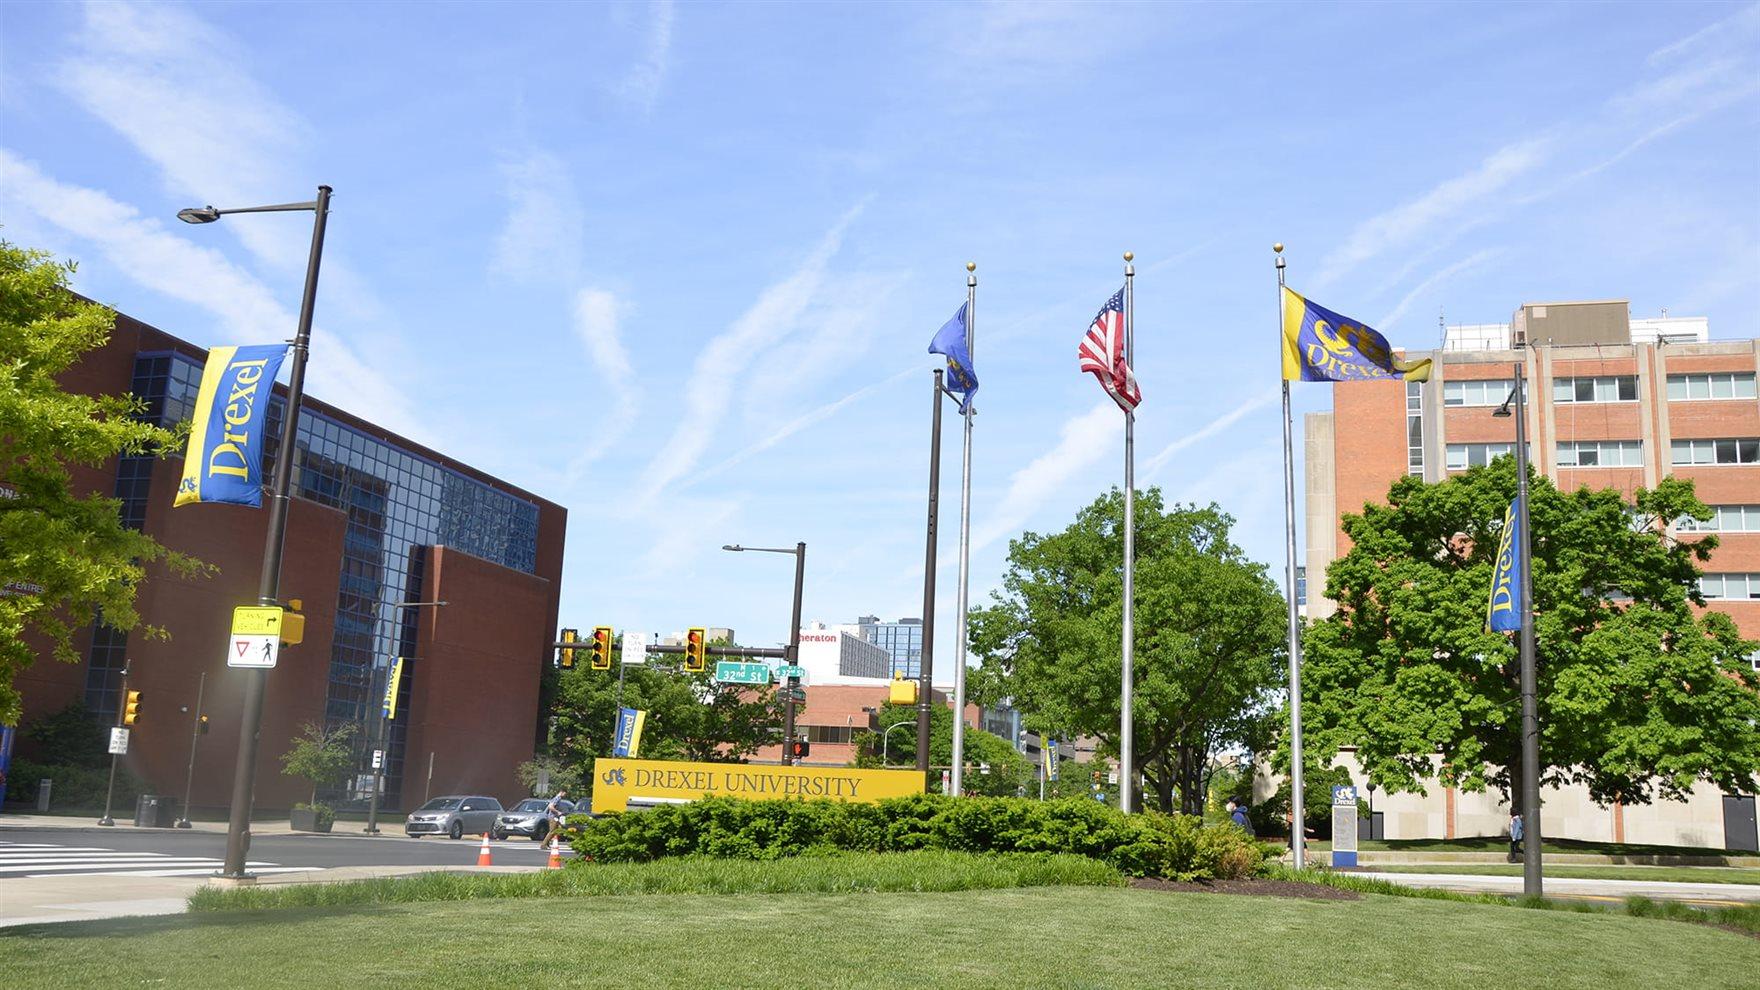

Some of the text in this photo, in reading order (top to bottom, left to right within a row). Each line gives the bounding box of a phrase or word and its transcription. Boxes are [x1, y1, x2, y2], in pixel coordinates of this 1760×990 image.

[209, 358, 268, 482] Drexel
[799, 633, 836, 642] heraton
[723, 670, 762, 681] 32nd St
[618, 714, 634, 750] Drexel
[634, 768, 862, 797] DREXEL UNIVERSITY
[1334, 797, 1356, 805] Drexel
